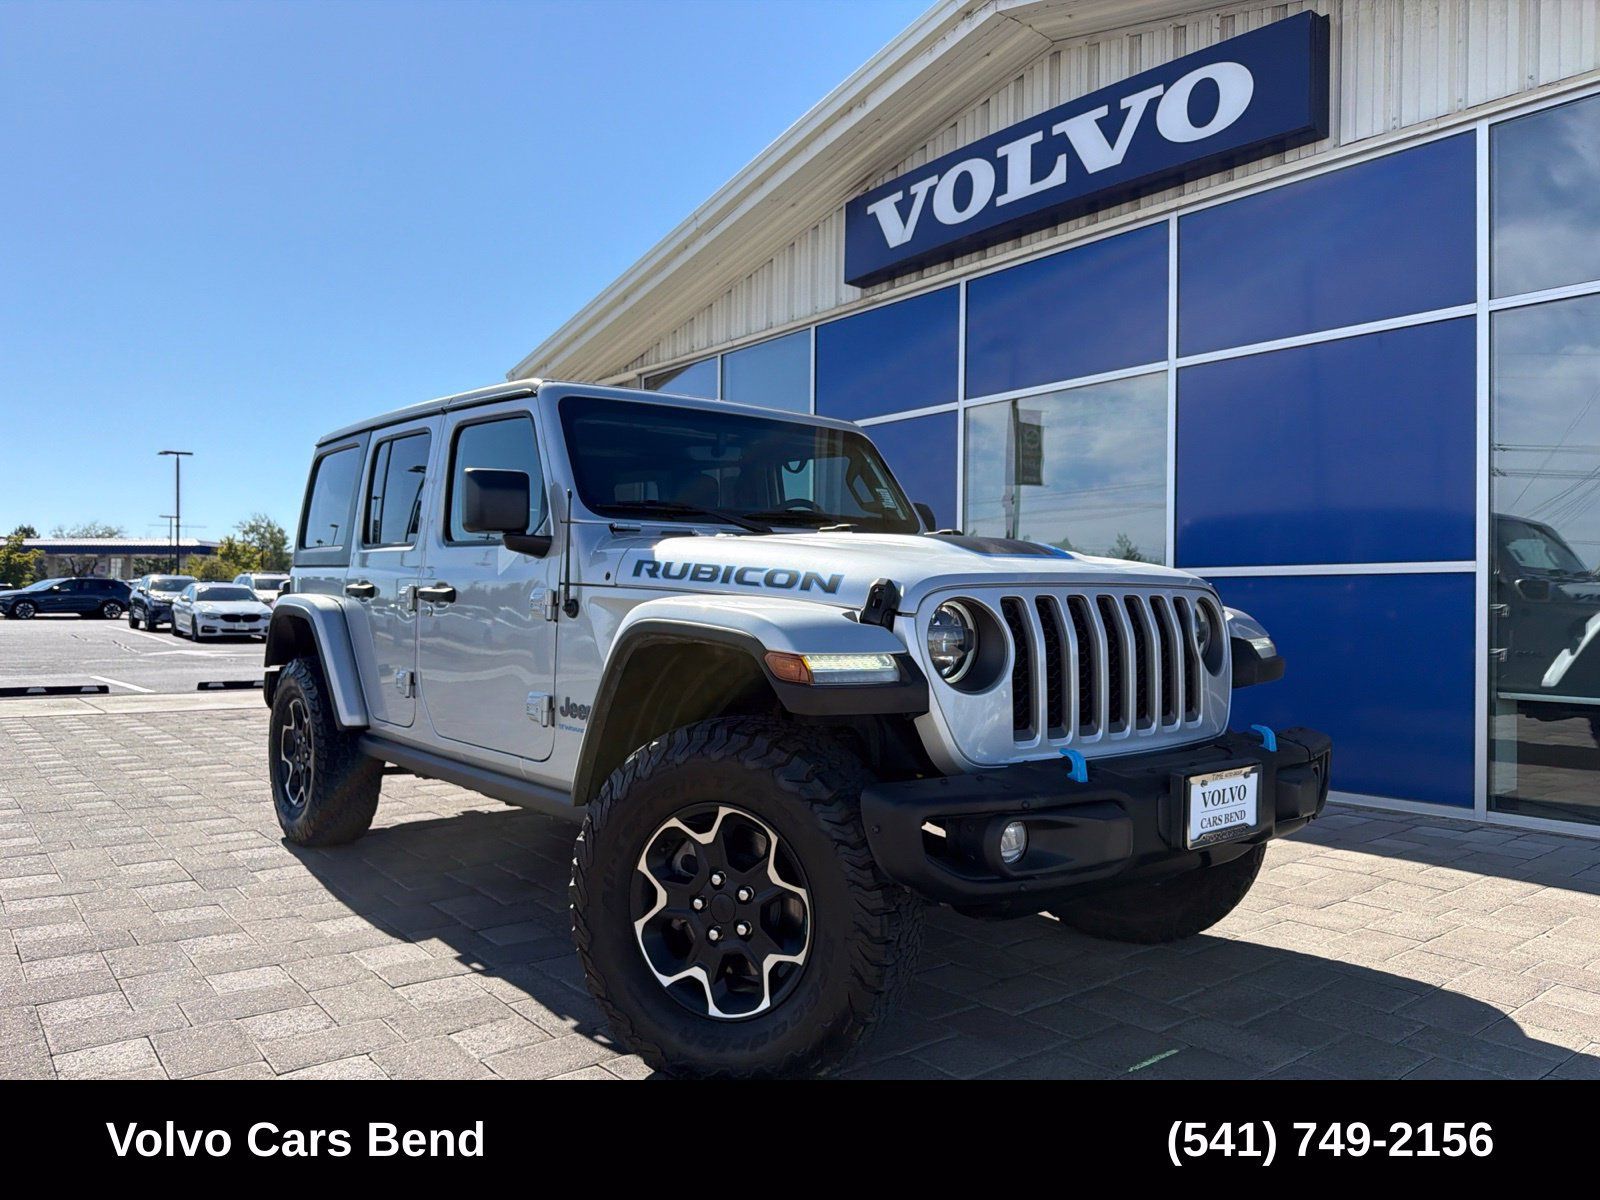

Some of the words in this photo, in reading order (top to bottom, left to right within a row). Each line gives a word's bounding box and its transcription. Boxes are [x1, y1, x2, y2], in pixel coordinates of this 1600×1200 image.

[867, 61, 1254, 249] VOLVO
[632, 559, 845, 595] RUBICON
[1202, 784, 1247, 808] VOLVO
[1201, 814, 1223, 829] CARS
[1224, 809, 1246, 824] BEND
